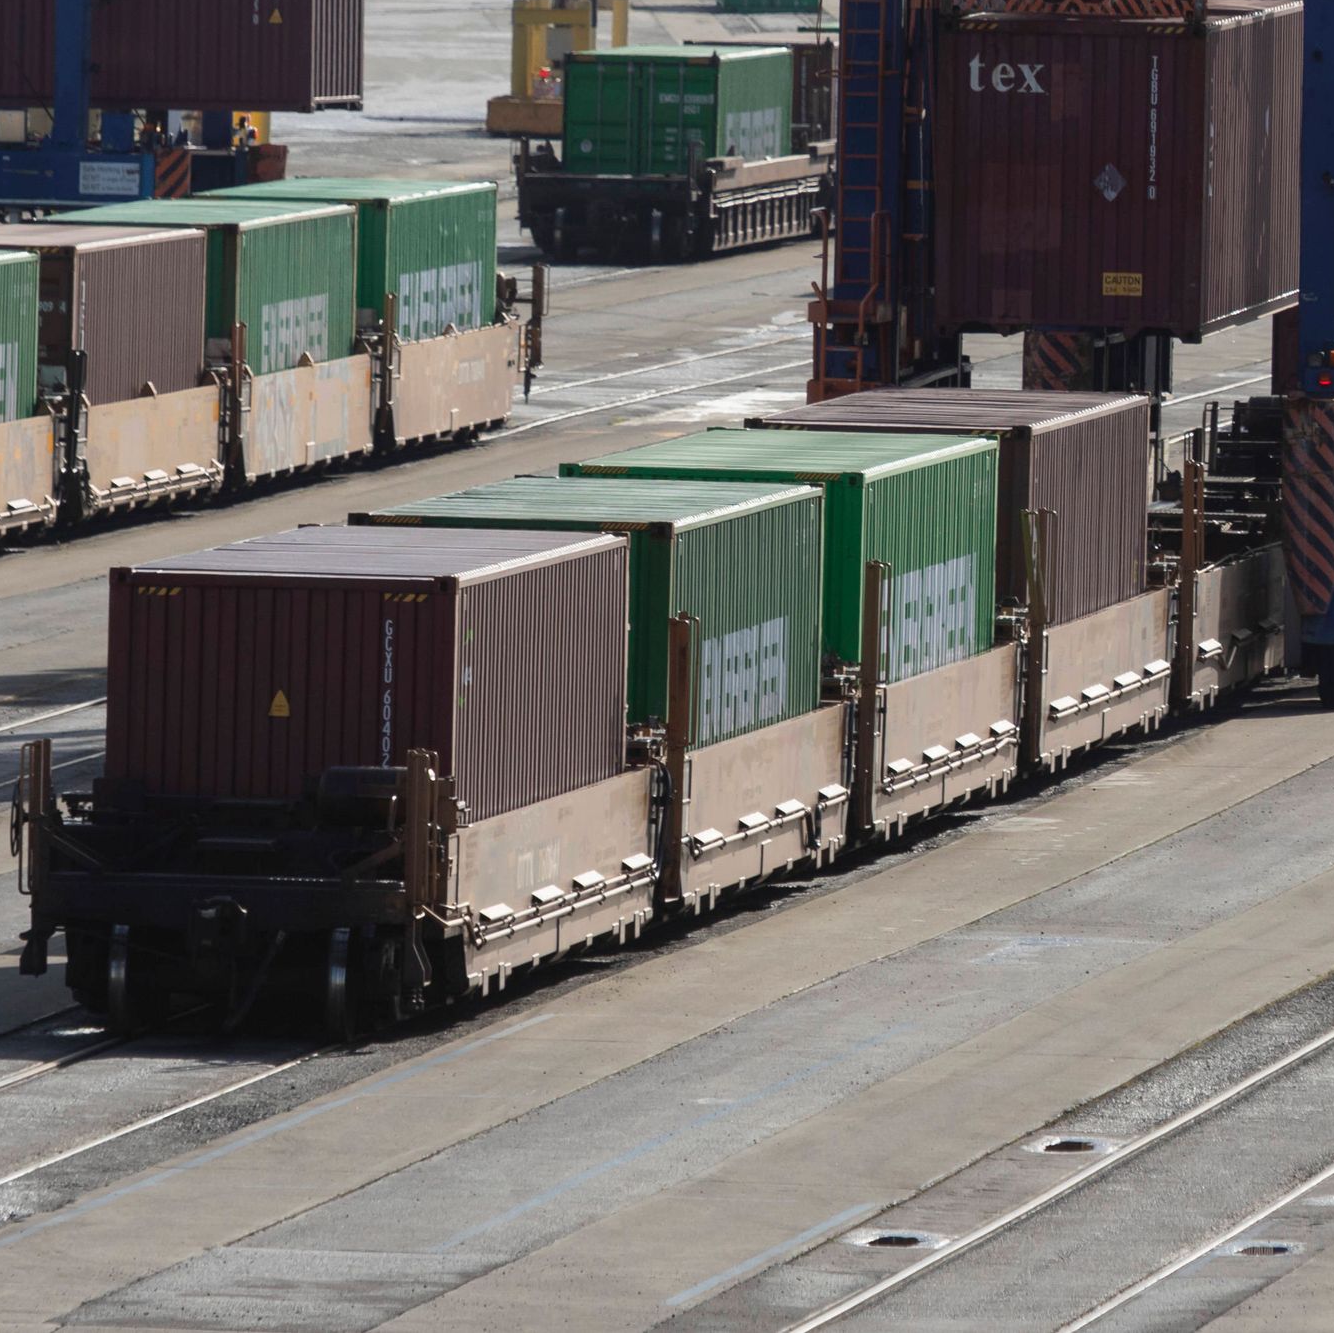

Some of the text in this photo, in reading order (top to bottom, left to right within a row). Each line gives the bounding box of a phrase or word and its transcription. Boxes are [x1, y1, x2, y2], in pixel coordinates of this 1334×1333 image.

[969, 52, 1046, 94] tex
[1150, 55, 1159, 106] TGBU
[384, 619, 394, 683] GCXU
